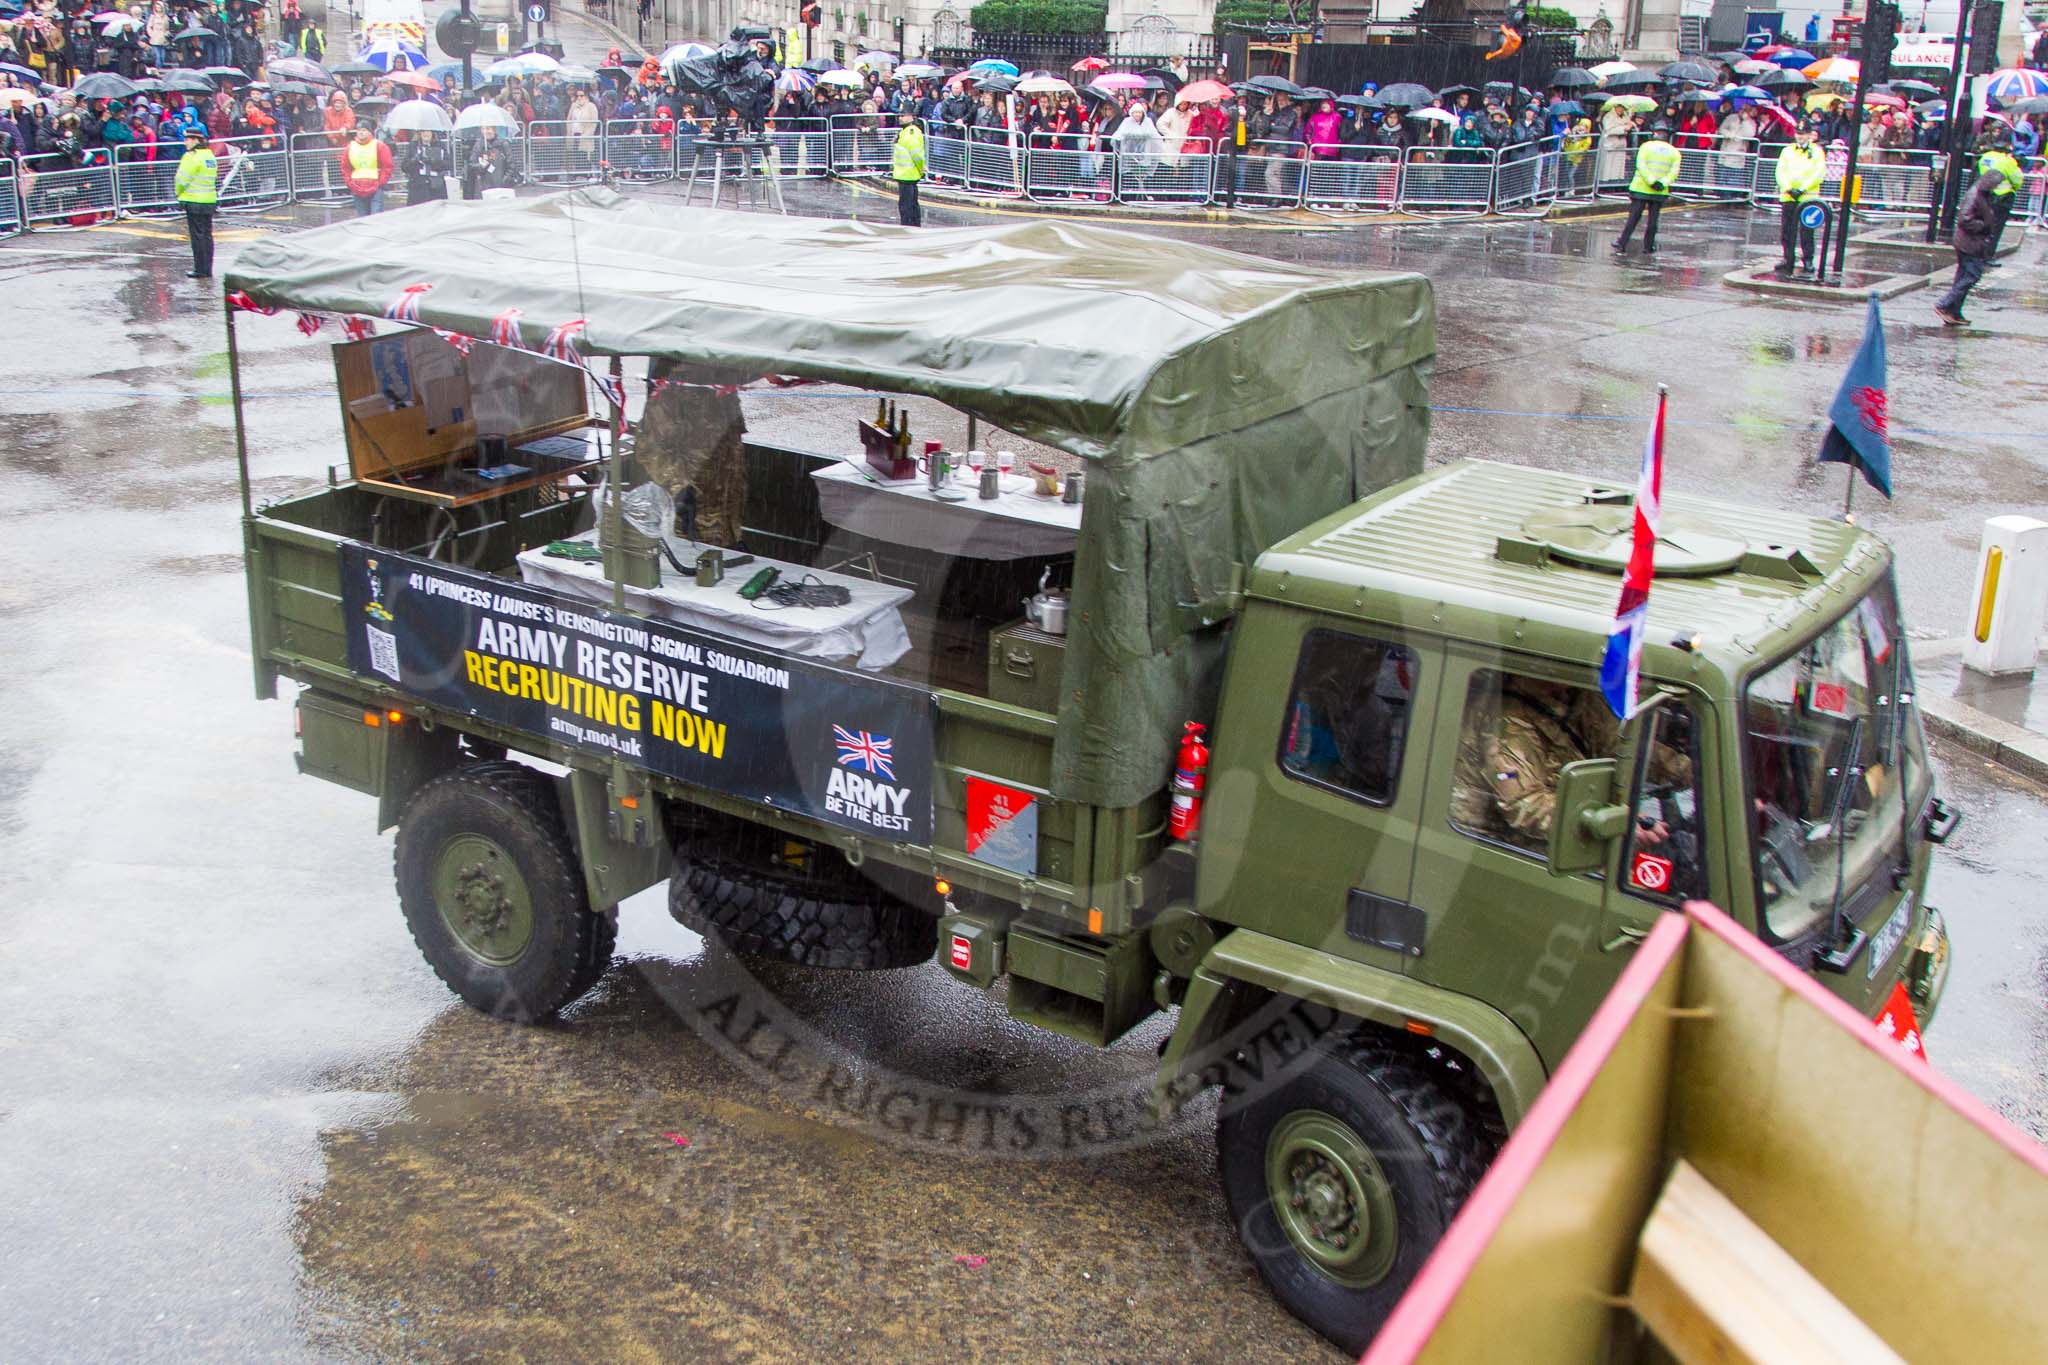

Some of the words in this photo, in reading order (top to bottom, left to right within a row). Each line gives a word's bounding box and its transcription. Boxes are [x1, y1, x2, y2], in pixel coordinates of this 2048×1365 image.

[408, 572, 424, 591] 41
[425, 576, 492, 609] (PRINCESS
[493, 594, 554, 623] LOUISE'S
[556, 608, 649, 651] KENSINGTON)
[651, 634, 704, 666] SIGNAL
[706, 650, 790, 690] SQUADRON
[477, 616, 568, 669] ARMY
[577, 639, 709, 713] RESERVE
[463, 649, 641, 731] RECRUITING
[651, 700, 728, 760] NOW
[550, 716, 642, 758] army.mod.uk
[825, 795, 844, 815] BE
[845, 799, 872, 824] THE
[872, 811, 913, 832] BEST
[826, 767, 911, 816] ARMY
